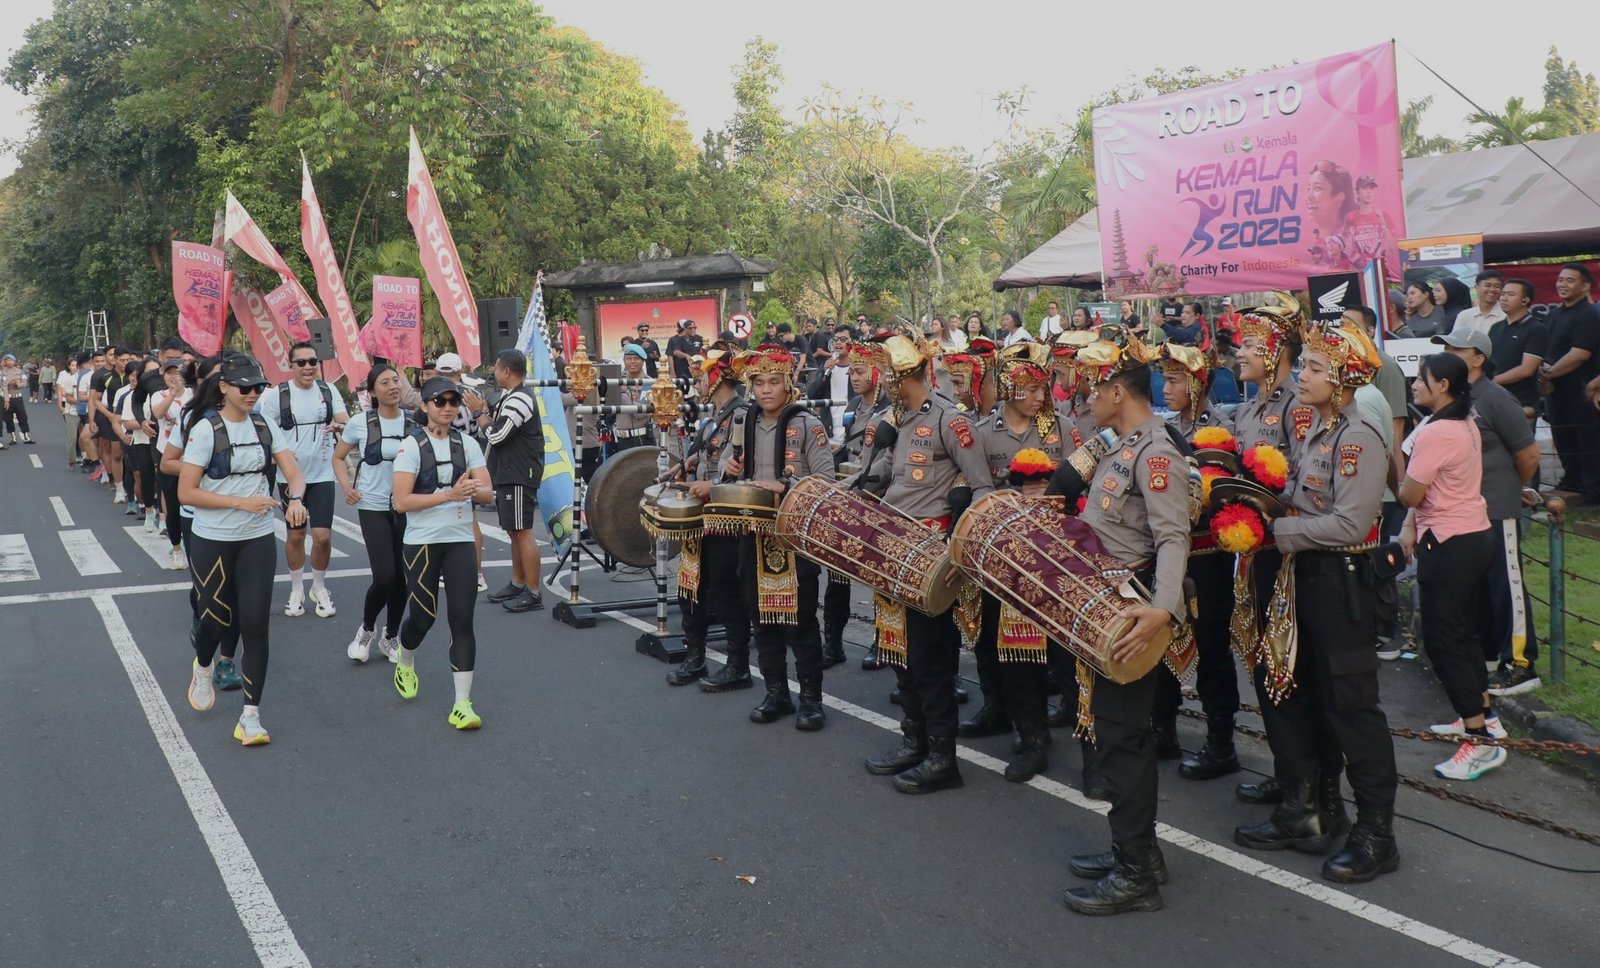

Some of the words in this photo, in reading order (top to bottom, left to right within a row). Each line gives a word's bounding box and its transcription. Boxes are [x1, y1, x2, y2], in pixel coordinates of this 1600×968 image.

[1157, 93, 1248, 139] ROAD
[1254, 80, 1304, 120] TO
[1257, 132, 1298, 149] Kemala
[1176, 150, 1298, 194] KEMALA
[1233, 182, 1299, 217] RUN
[1217, 215, 1301, 250] 2026
[178, 248, 210, 262] ROAD
[211, 254, 223, 267] TO
[1180, 264, 1218, 277] Charity
[1221, 262, 1239, 273] For
[1242, 257, 1301, 272] Indonesia
[377, 282, 402, 294] ROAD
[405, 284, 418, 295] TO
[381, 301, 416, 311] KEMALA
[1319, 306, 1346, 314] HOND
[395, 311, 417, 320] RUN
[391, 319, 417, 328] 2026
[735, 319, 746, 334] P
[1258, 429, 1278, 437] POLRI
[910, 439, 932, 447] POLRI
[1111, 461, 1130, 477] POLRI
